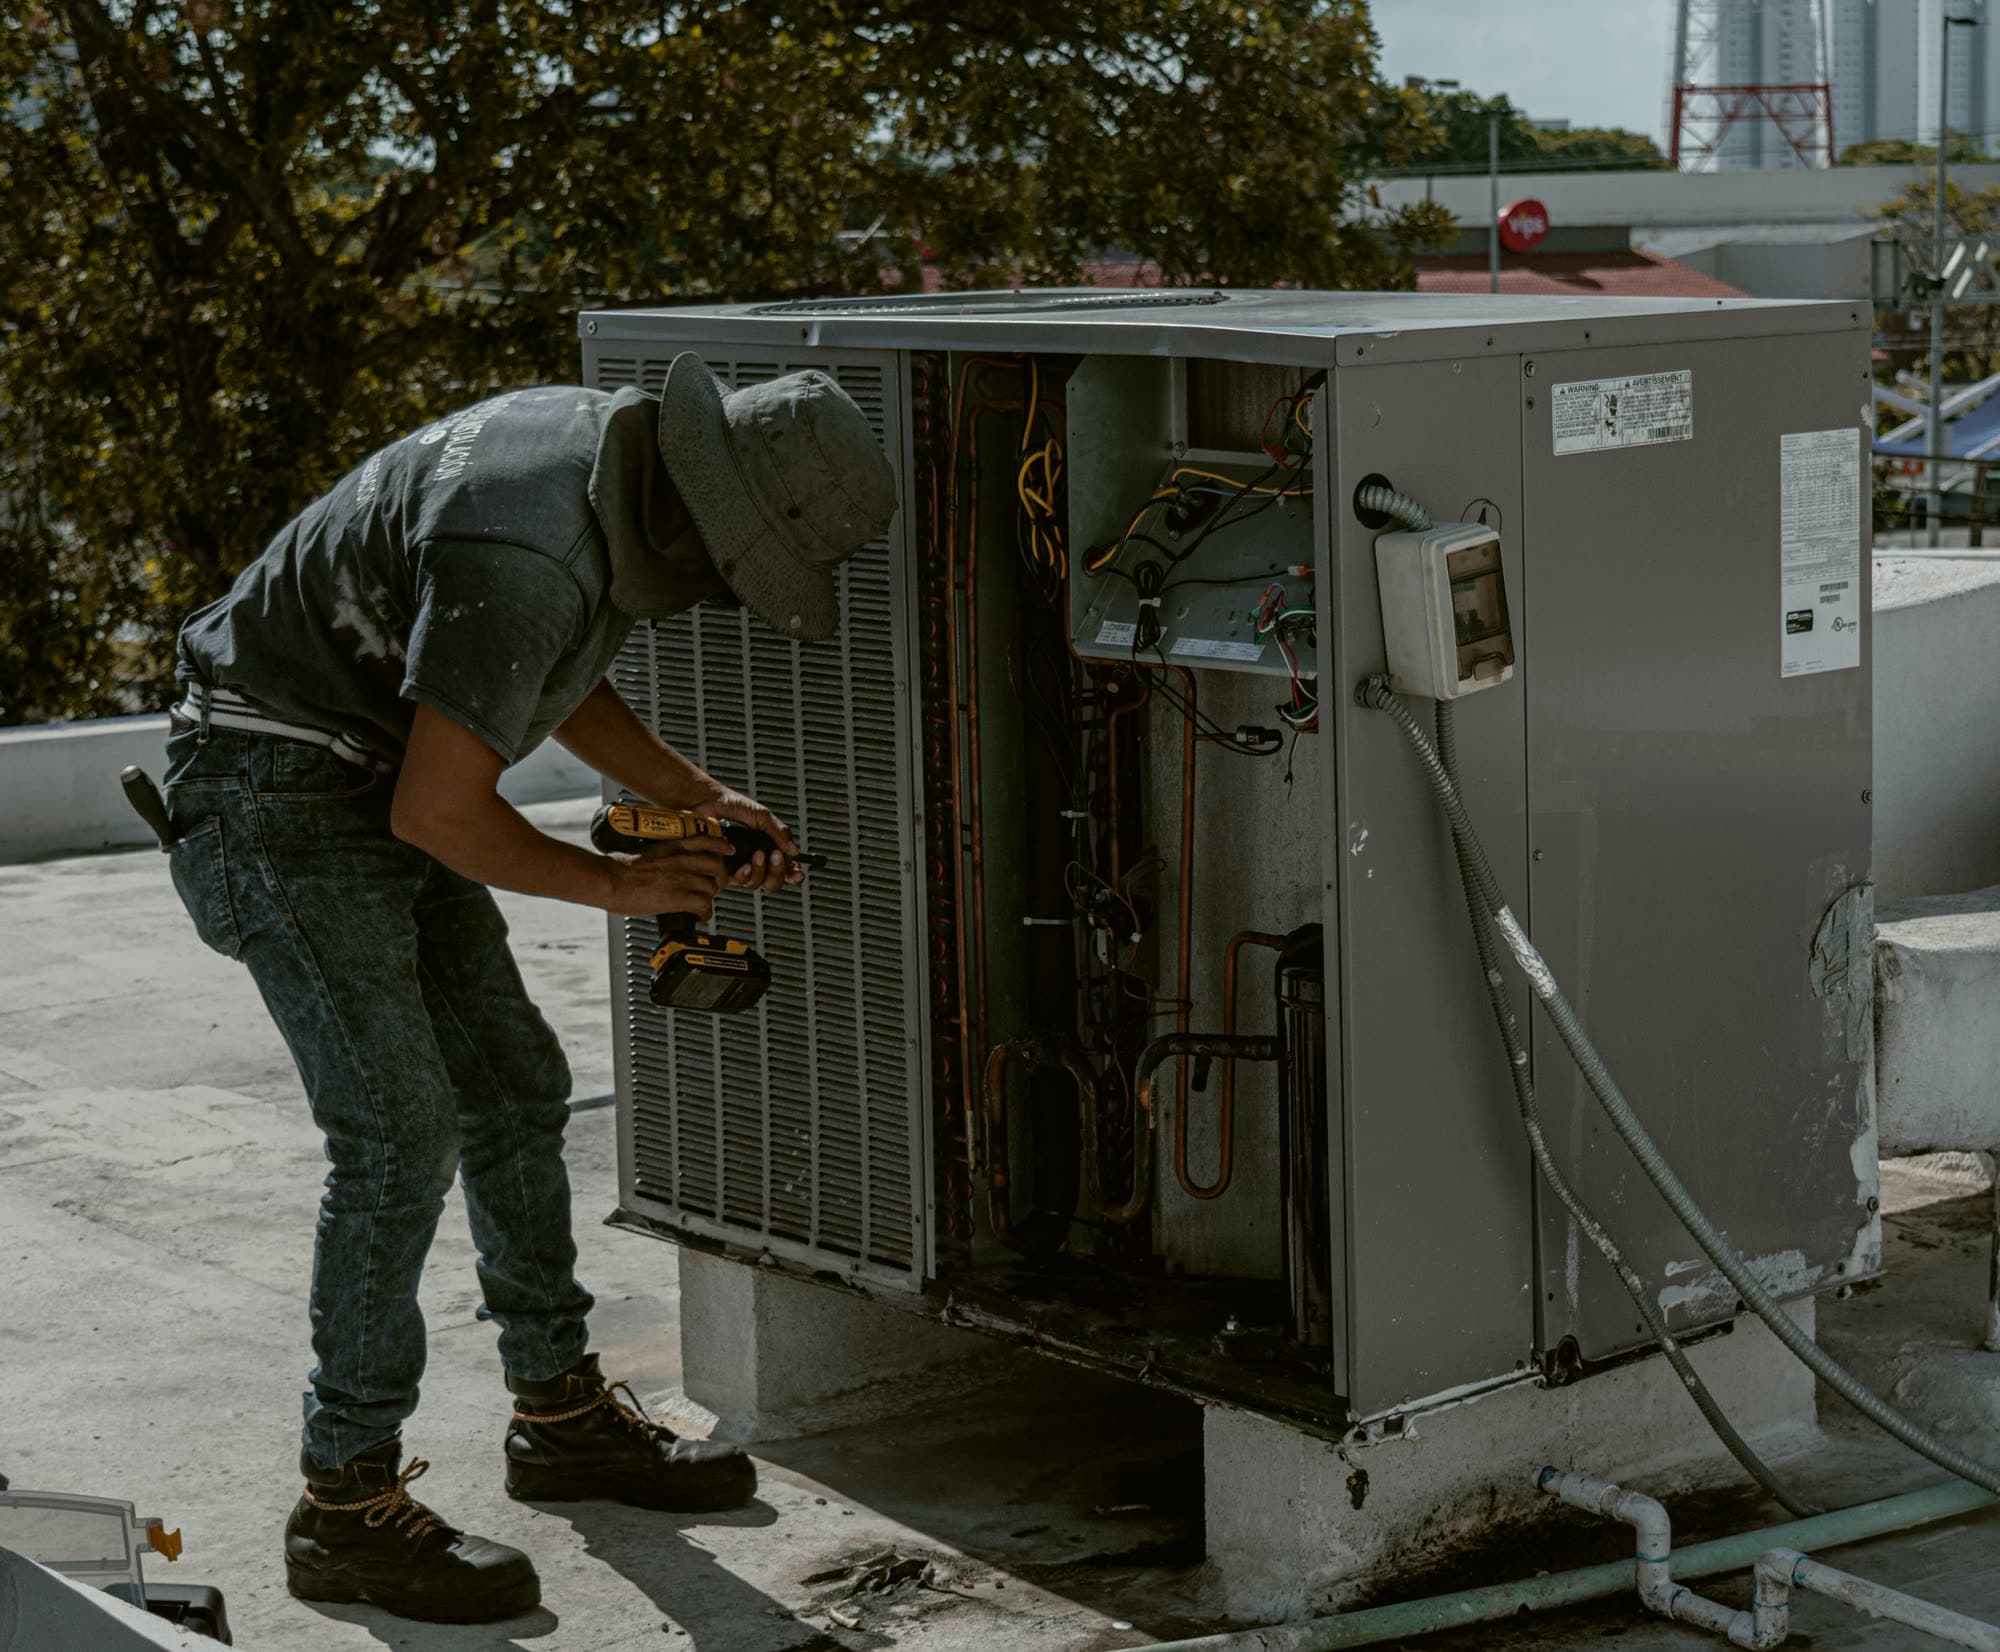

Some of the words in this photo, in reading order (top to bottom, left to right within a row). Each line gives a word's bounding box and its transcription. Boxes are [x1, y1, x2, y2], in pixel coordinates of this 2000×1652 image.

[1508, 210, 1546, 240] vips
[1567, 383, 1600, 393] WARNING
[1632, 374, 1683, 386] AVERTISSEMENT
[433, 409, 493, 481] NSTALACIÓN
